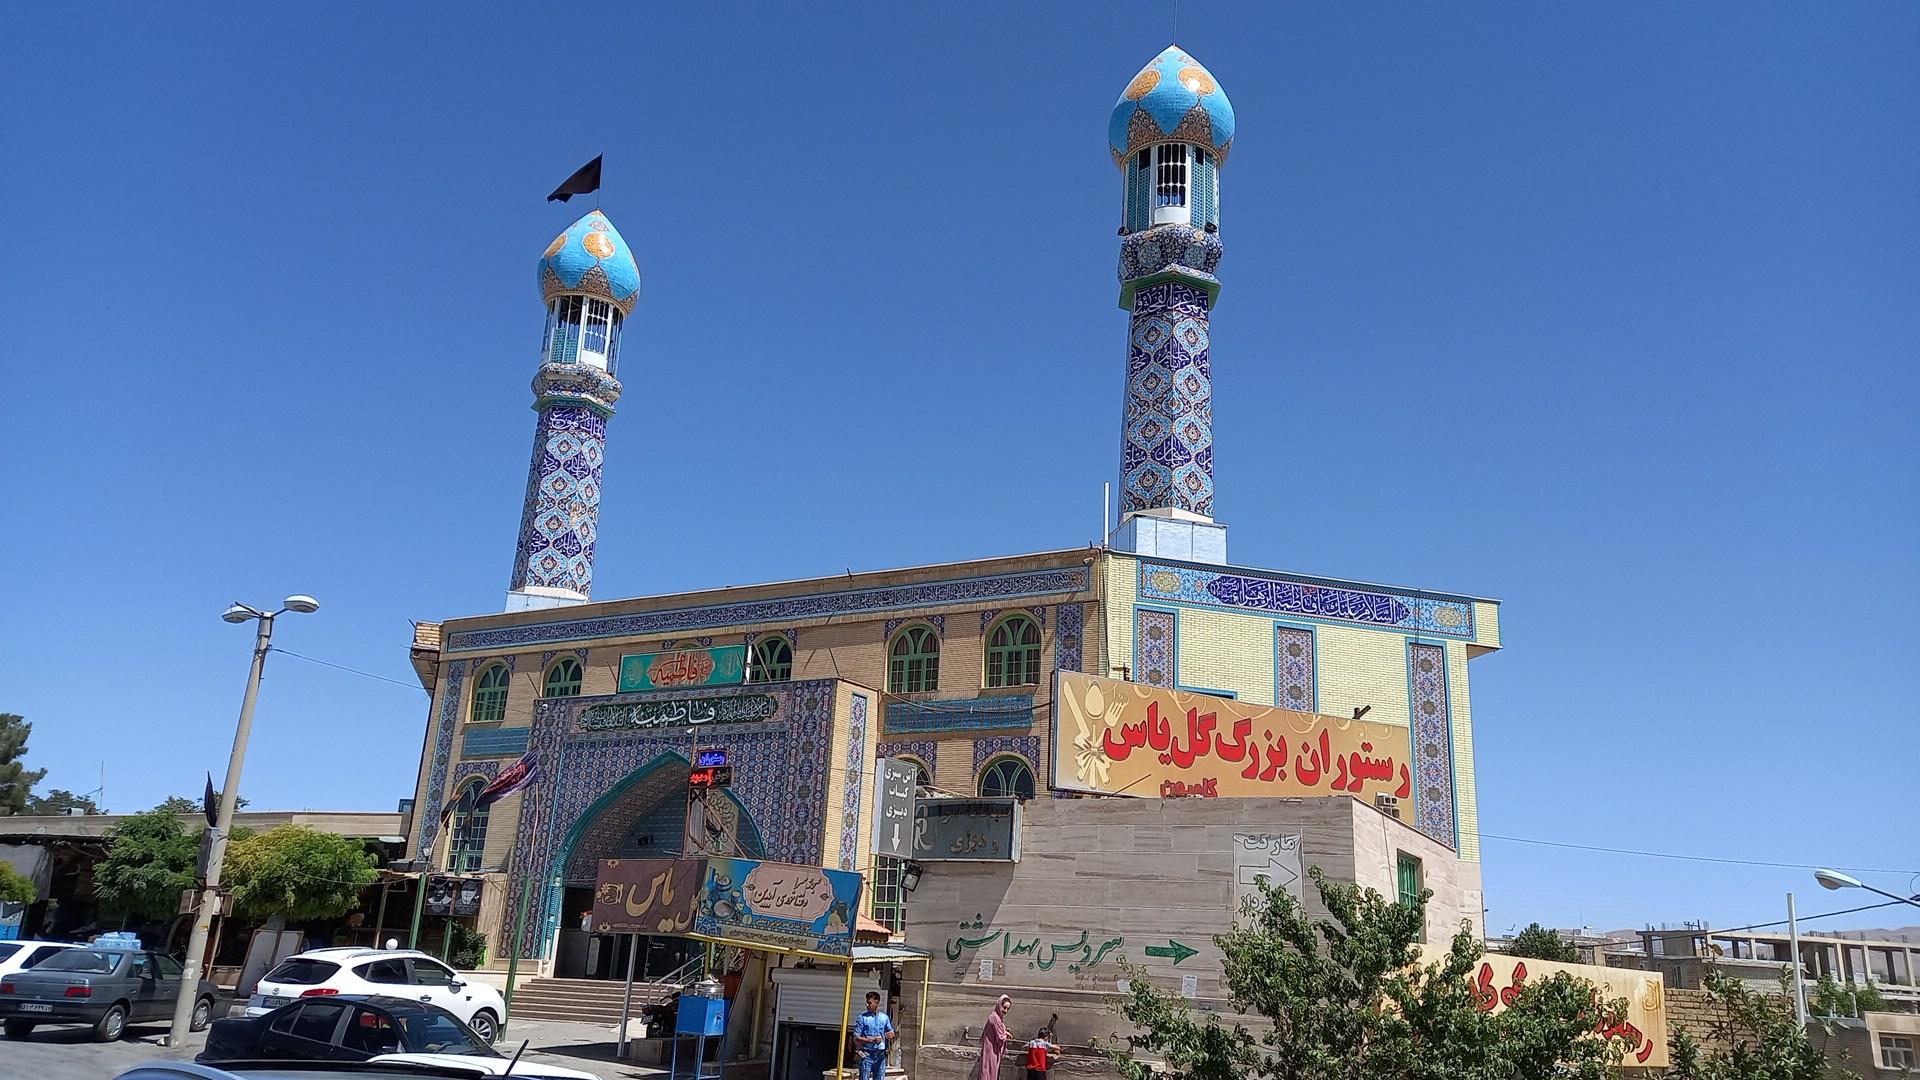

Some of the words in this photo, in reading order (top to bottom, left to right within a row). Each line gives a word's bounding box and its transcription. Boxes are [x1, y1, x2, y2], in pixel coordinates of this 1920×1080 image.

[1102, 701, 1171, 765] یاس
[1170, 707, 1217, 770] گل
[1215, 718, 1288, 782] بزرگ
[885, 767, 902, 781] سبزی
[902, 768, 915, 784] آش
[1295, 727, 1412, 799] رستوران
[885, 805, 908, 819] دیزی
[888, 784, 909, 801] کباب
[1243, 833, 1296, 855] مارکت
[626, 867, 674, 933] یاس
[945, 912, 1041, 970] بهداشتی
[1037, 929, 1125, 973] سرویس
